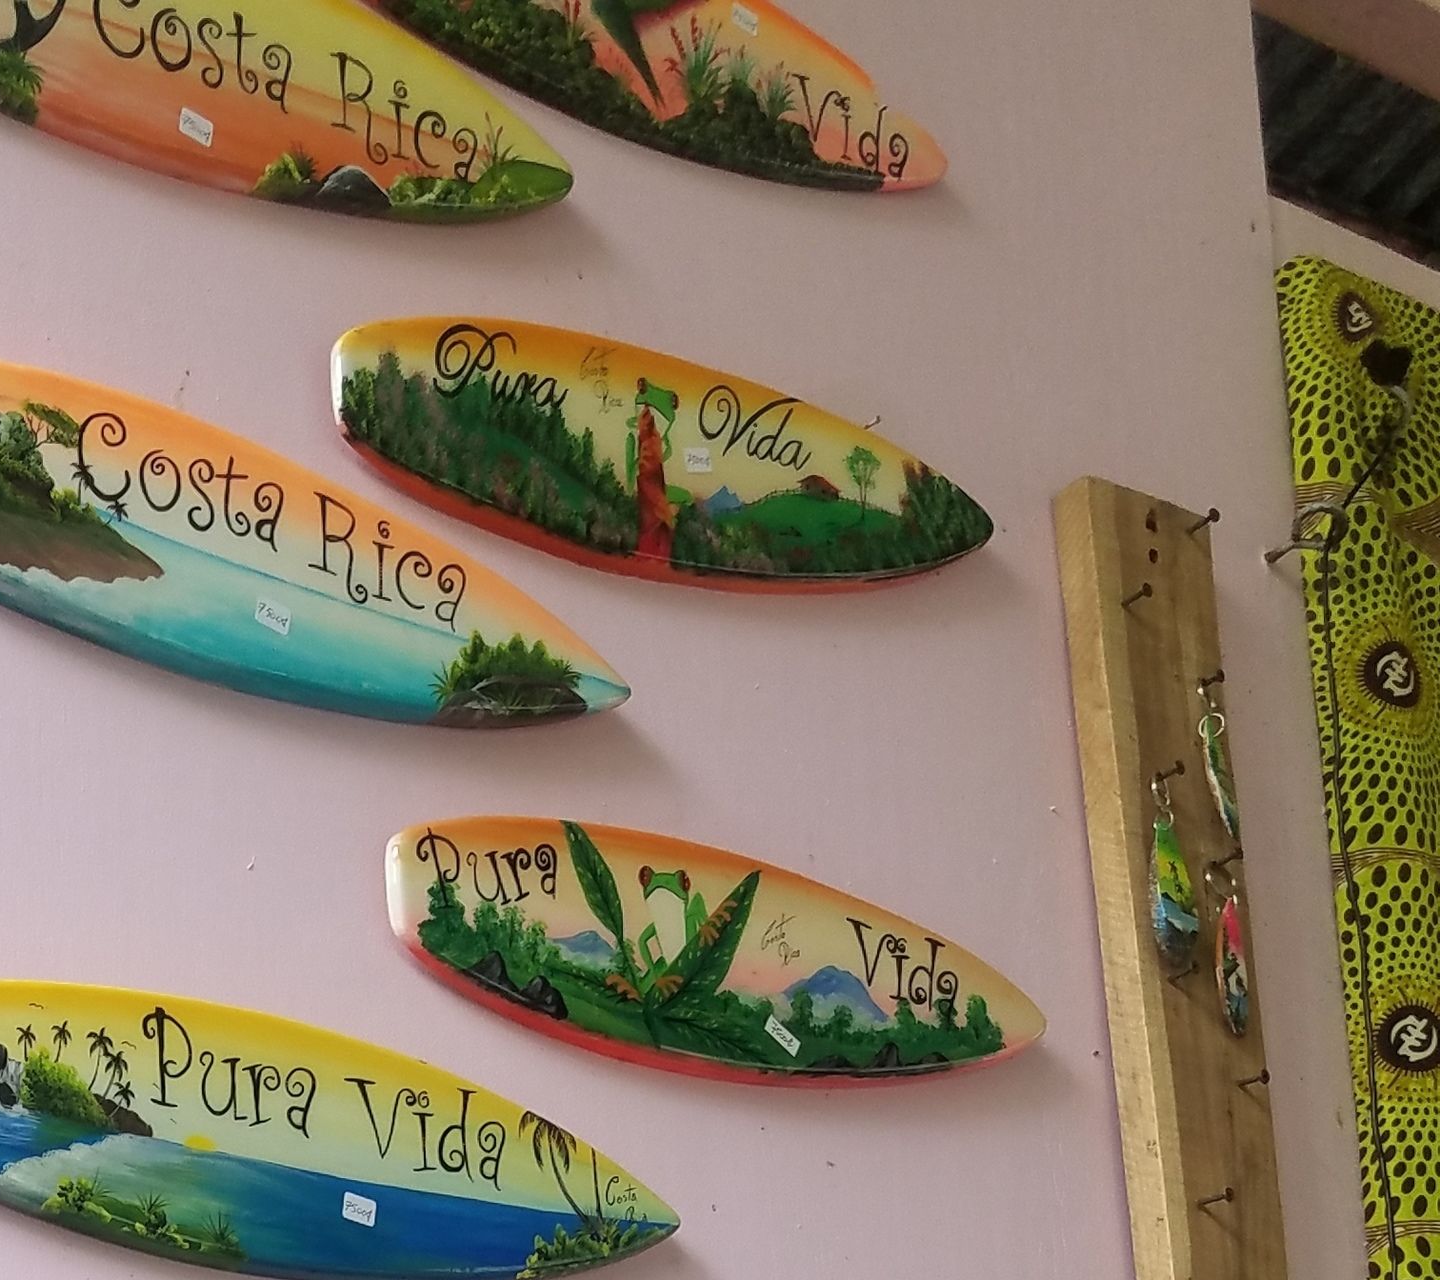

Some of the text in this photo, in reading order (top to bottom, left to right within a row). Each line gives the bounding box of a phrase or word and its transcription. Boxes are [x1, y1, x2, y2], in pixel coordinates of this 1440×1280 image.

[94, 0, 480, 184] Costa Rica
[792, 73, 910, 182] Vida
[432, 323, 811, 471] Pura Vida
[77, 411, 468, 633] Costa Rica
[415, 827, 959, 1028] Pura Vida
[142, 1004, 508, 1192] Pura Vida
[605, 1175, 638, 1206] Costa
